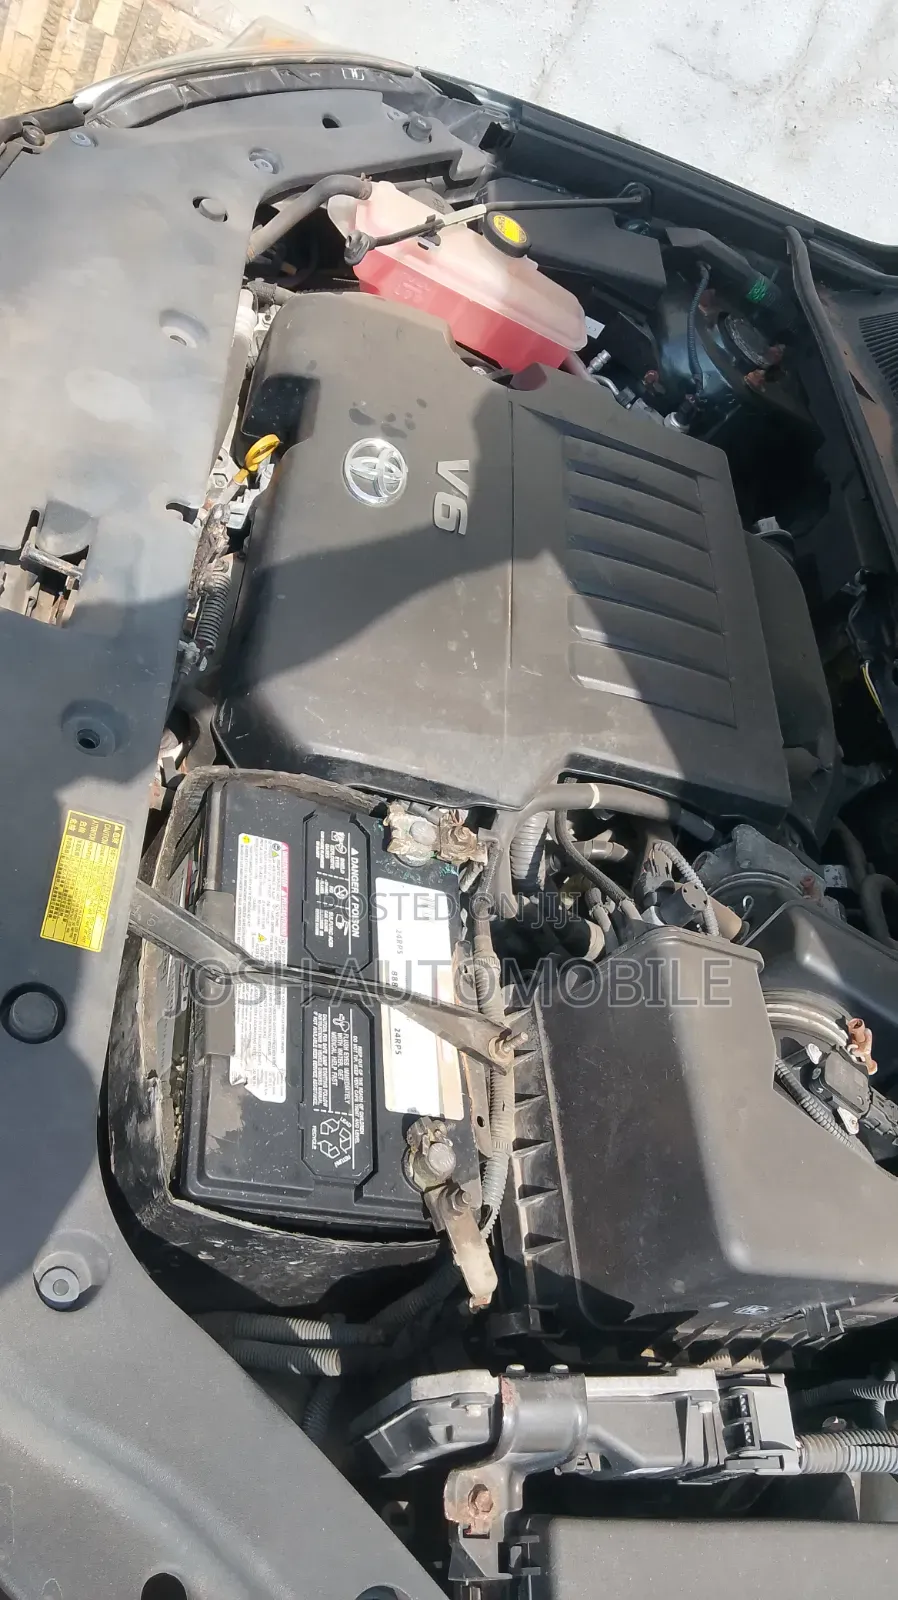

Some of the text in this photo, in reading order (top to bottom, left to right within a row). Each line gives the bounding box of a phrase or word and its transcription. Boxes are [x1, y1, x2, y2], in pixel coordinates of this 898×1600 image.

[434, 460, 469, 535] V6
[101, 824, 111, 844] CAUTION
[351, 857, 359, 893] DANGER
